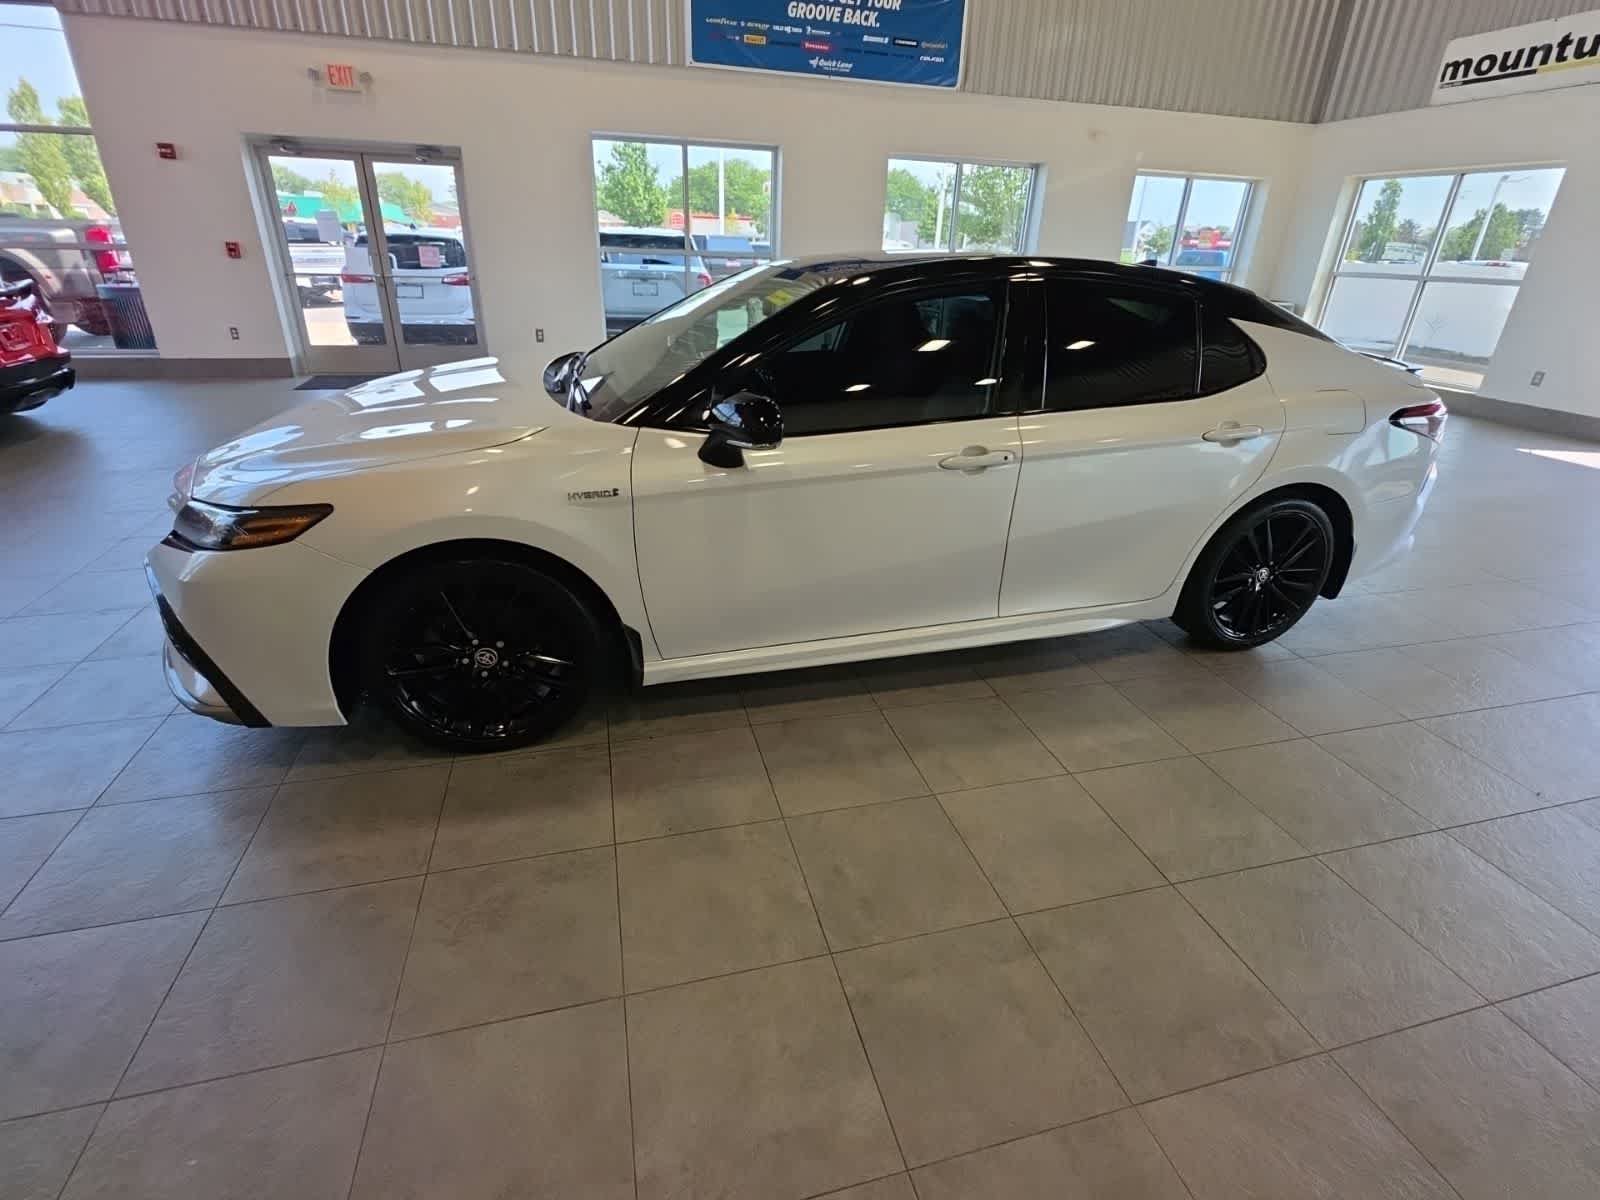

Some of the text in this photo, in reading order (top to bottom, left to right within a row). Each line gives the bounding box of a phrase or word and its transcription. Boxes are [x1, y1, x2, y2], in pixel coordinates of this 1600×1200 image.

[787, 1, 880, 27] GROOVE BACK.
[1440, 32, 1600, 82] mountu
[327, 65, 353, 87] EXIT
